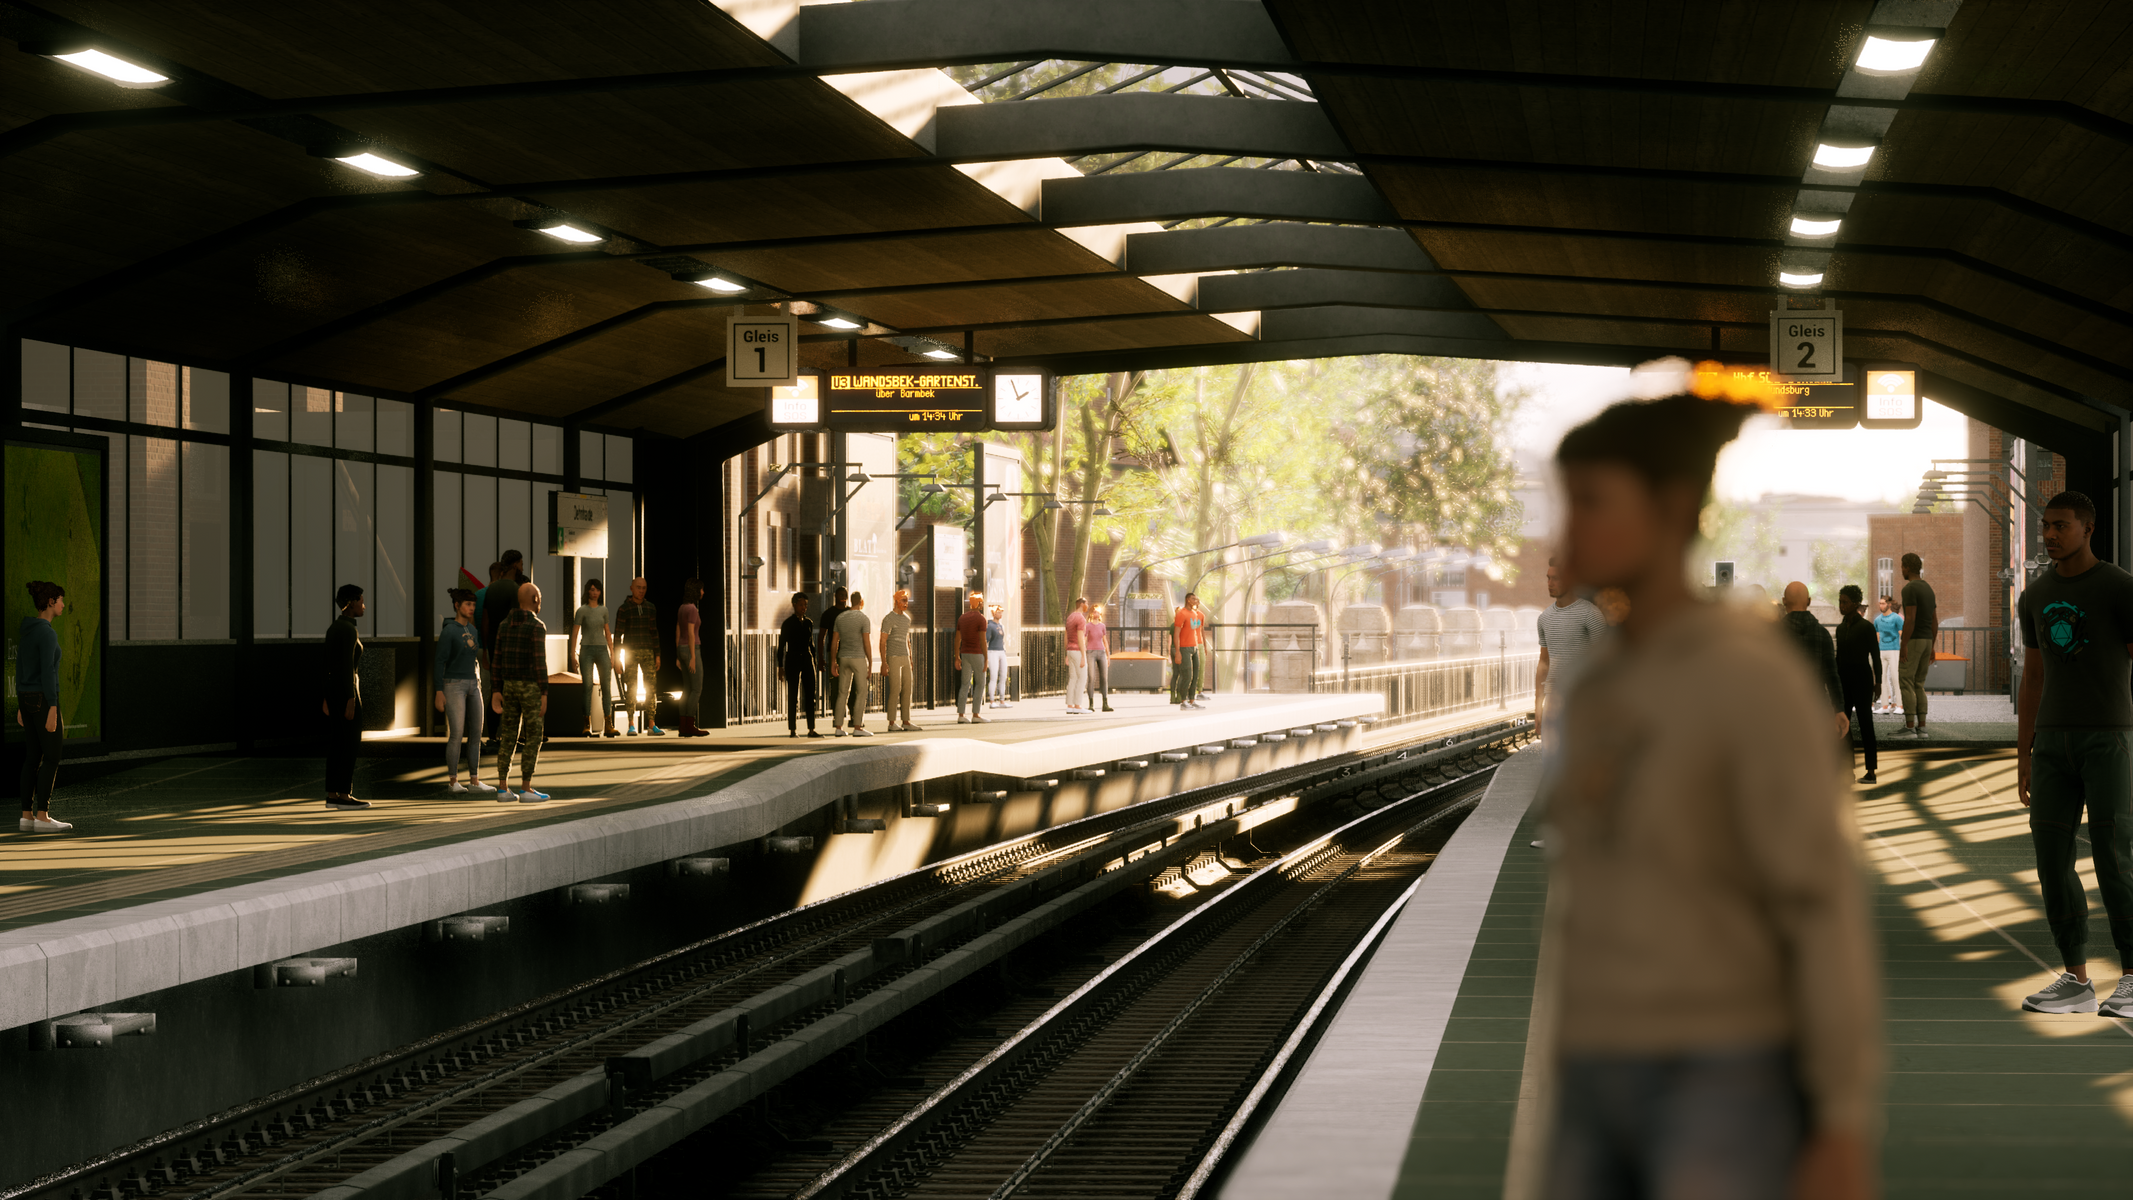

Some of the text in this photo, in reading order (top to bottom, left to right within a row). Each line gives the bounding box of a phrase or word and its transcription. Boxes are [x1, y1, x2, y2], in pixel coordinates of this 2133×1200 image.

[1788, 324, 1825, 337] Gleis
[743, 329, 779, 343] Gleis
[1796, 341, 1816, 368] 2
[754, 347, 765, 373] 1
[832, 375, 979, 389] U3 WANDSBEK-GARTENST.
[900, 389, 935, 398] Barmbek
[1767, 386, 1810, 396] undsburg
[1879, 397, 1903, 406] Info
[784, 402, 807, 411] Info
[783, 411, 807, 420] SOS
[1792, 408, 1817, 418] 14:33
[1819, 408, 1834, 418] Uhr
[1878, 407, 1903, 416] SOS
[908, 412, 964, 421] um 14:34 Uhr
[1445, 738, 1454, 747] 6
[1397, 751, 1408, 760] 4
[1341, 767, 1351, 777] 3
